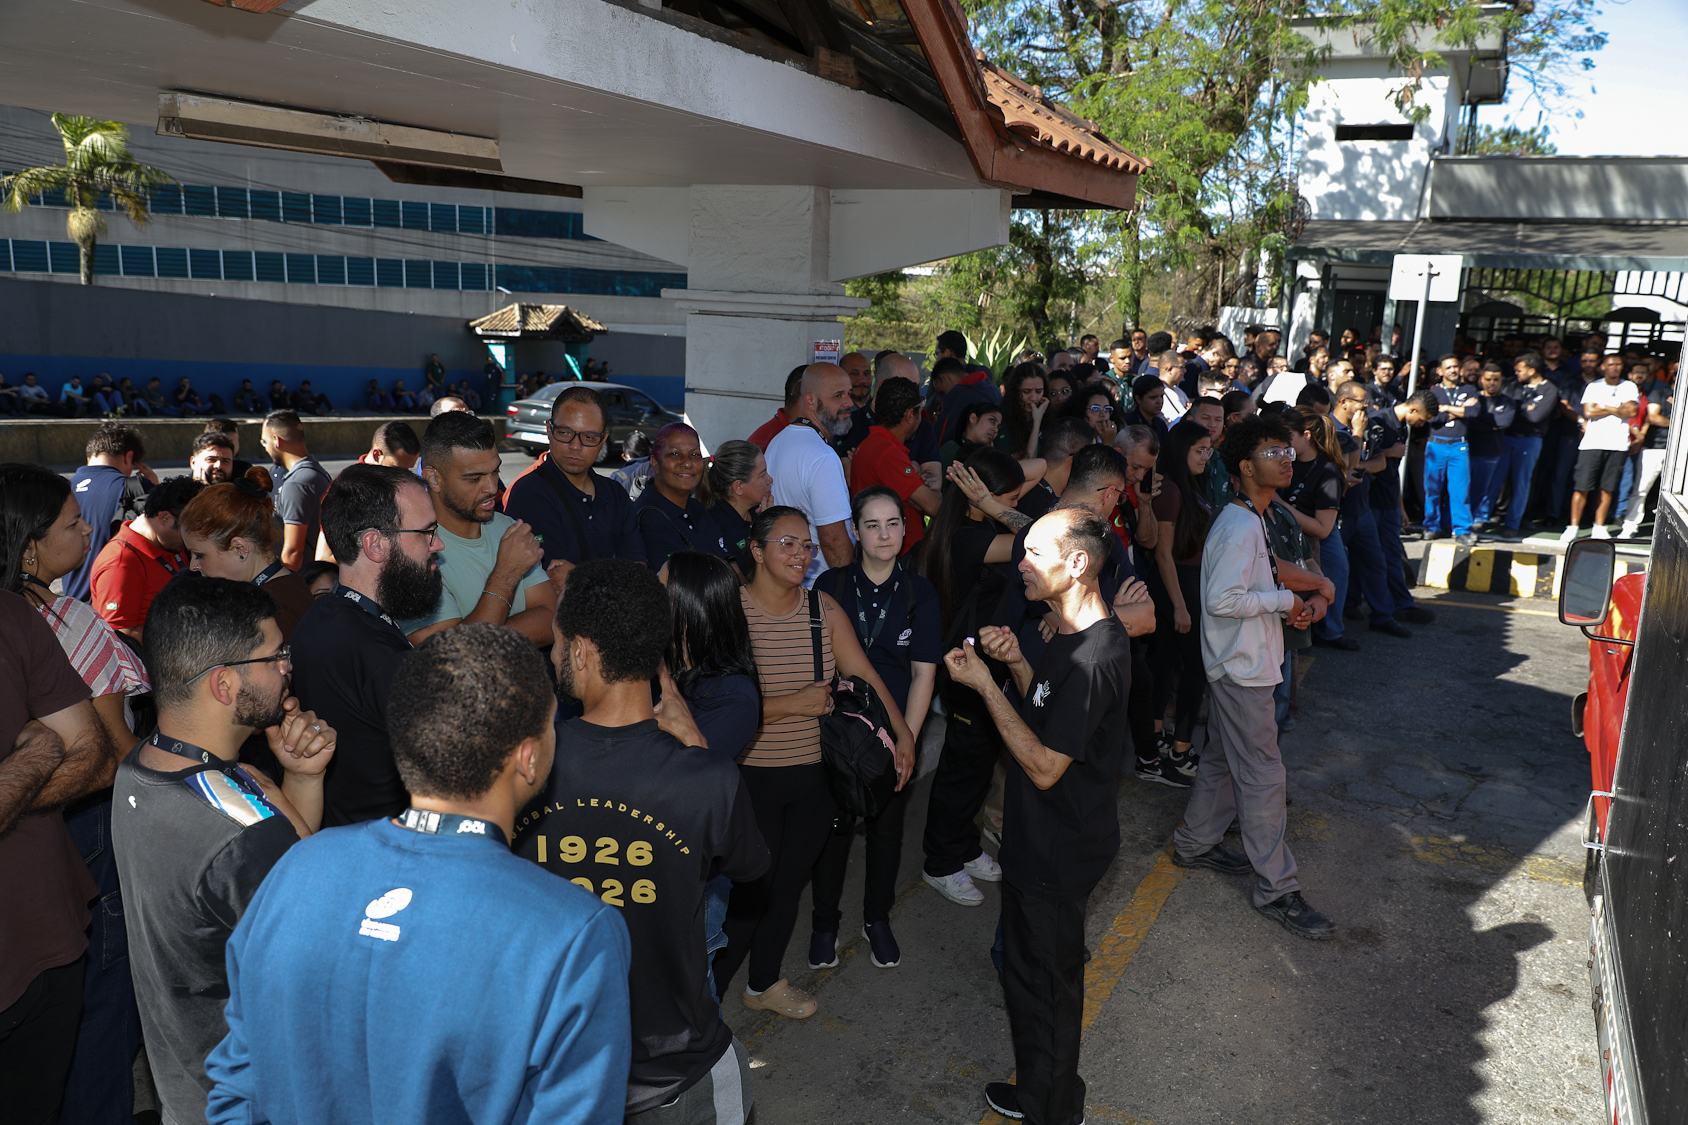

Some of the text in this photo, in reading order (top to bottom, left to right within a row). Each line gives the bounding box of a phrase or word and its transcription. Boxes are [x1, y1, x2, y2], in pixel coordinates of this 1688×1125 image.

[511, 798, 690, 855] GLOBAL LEADERSHIP
[537, 835, 654, 867] 1926
